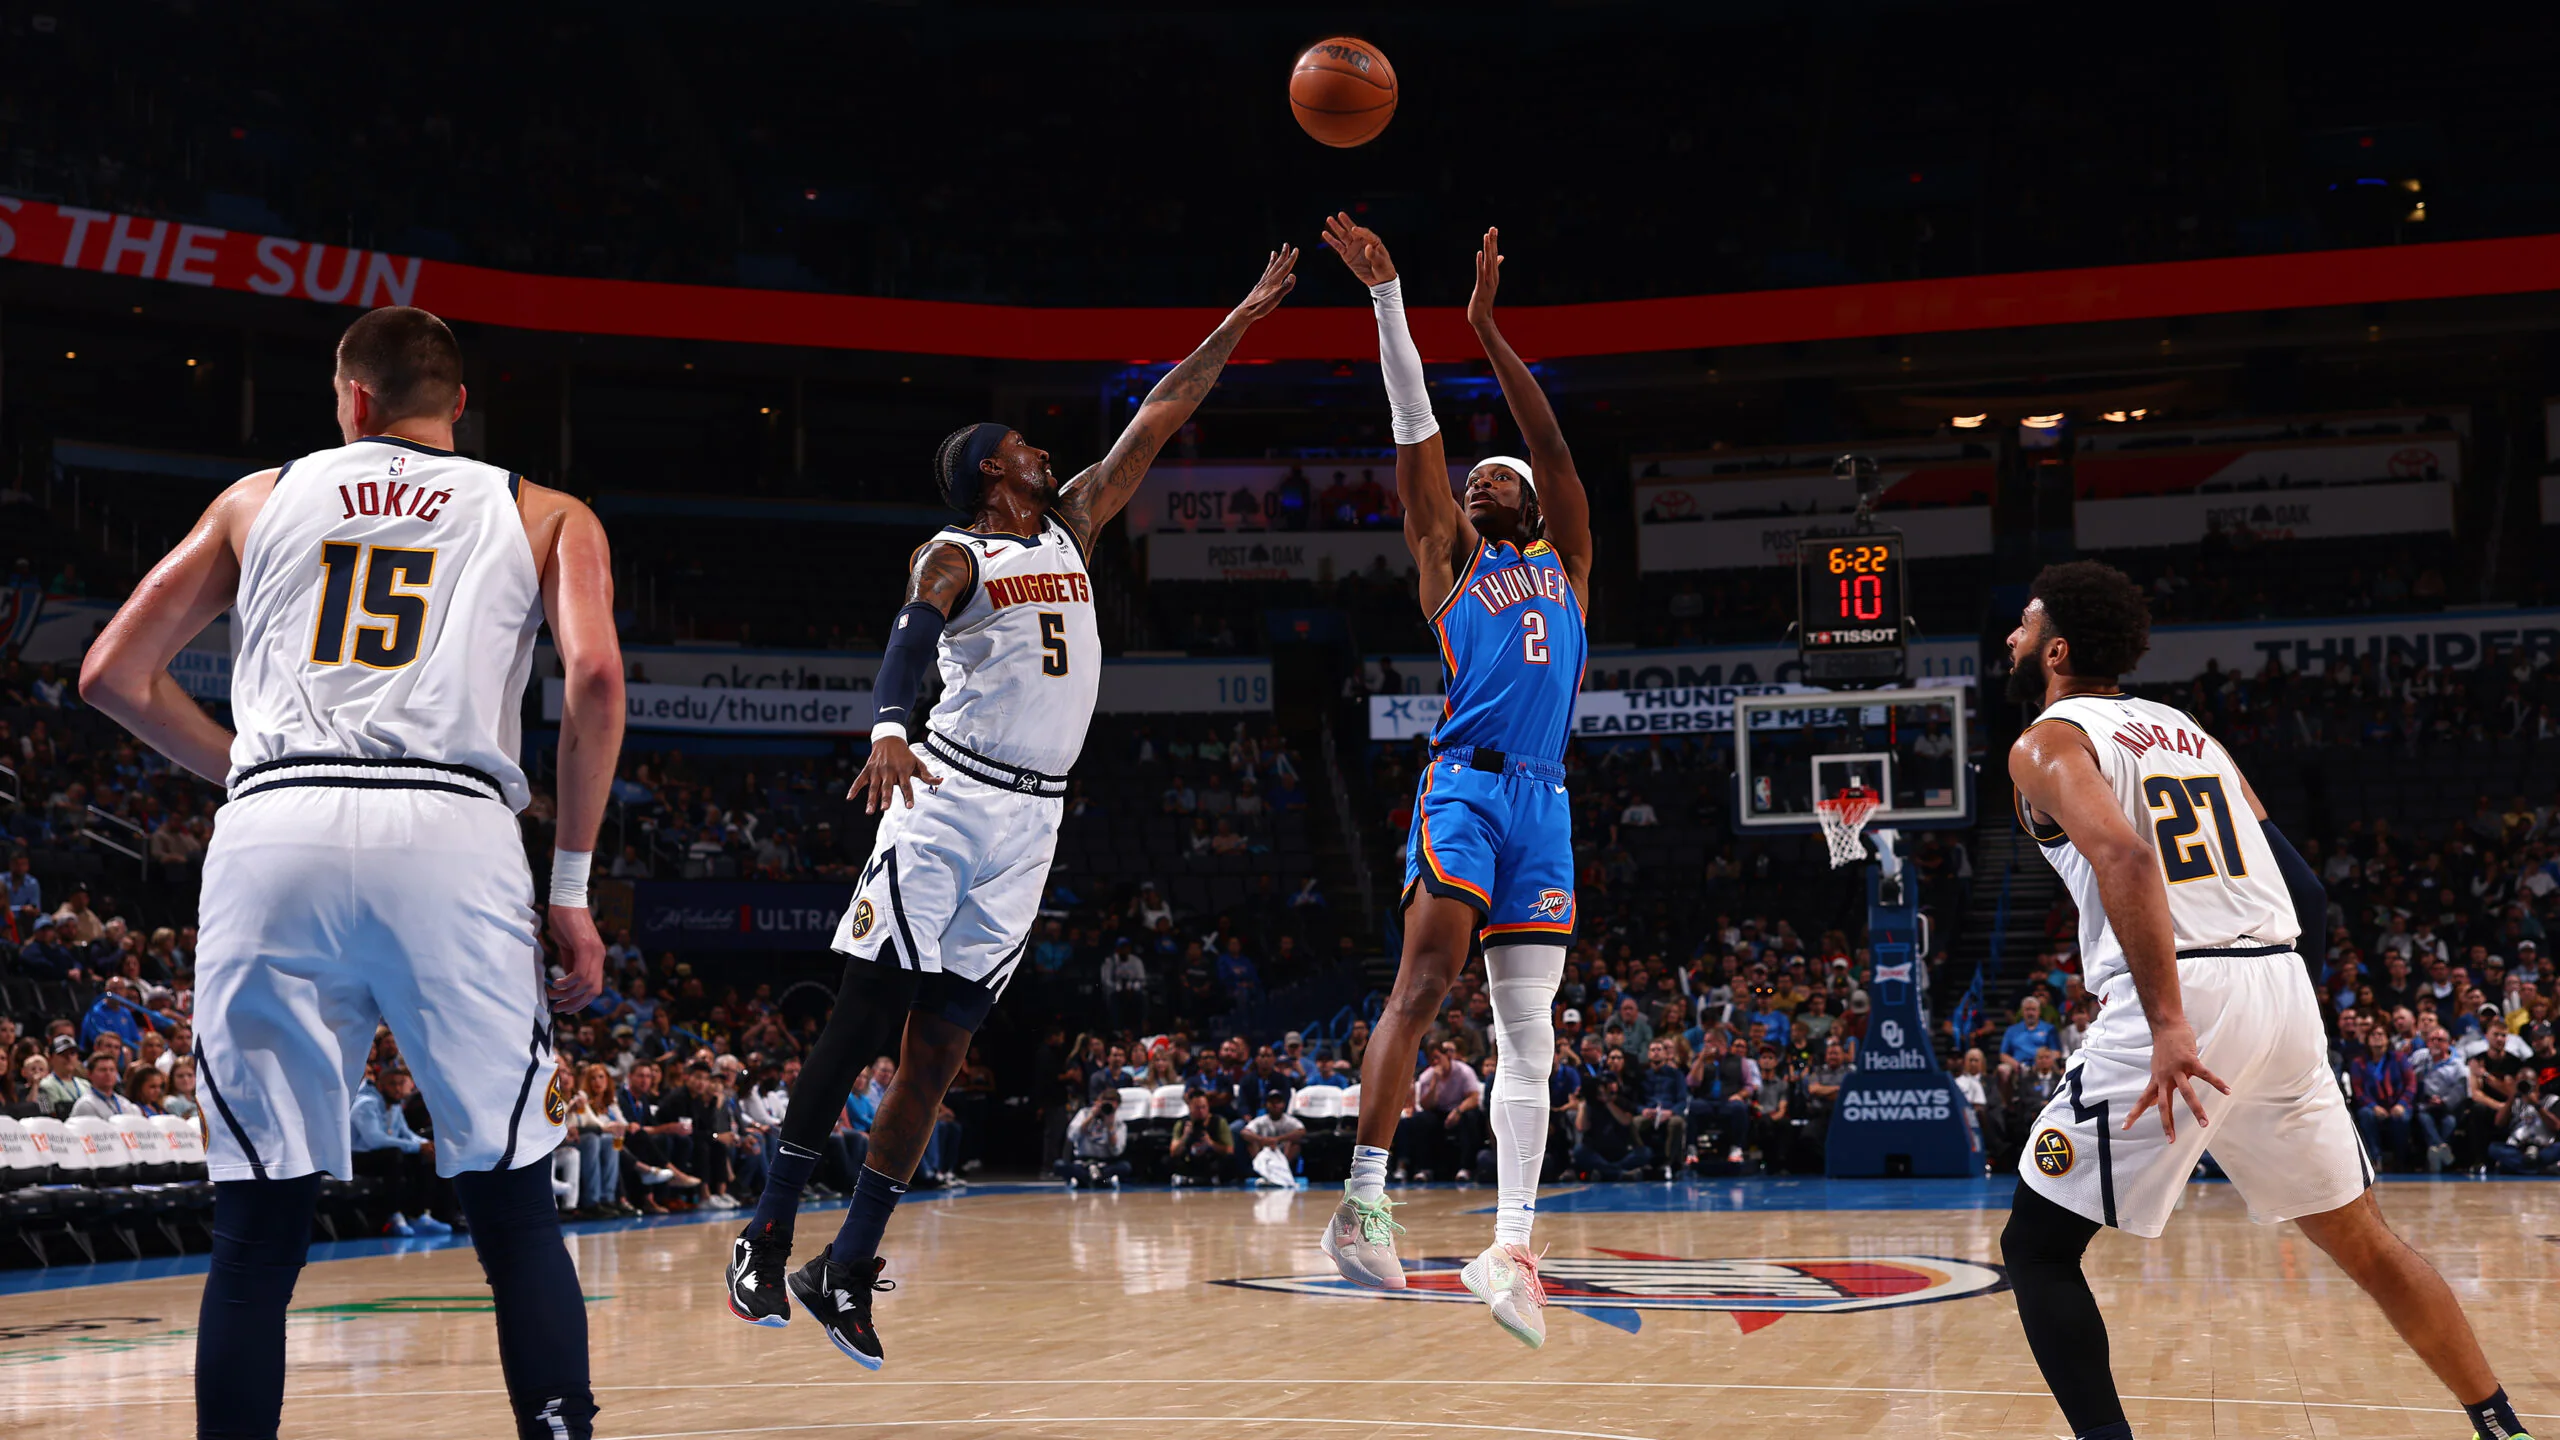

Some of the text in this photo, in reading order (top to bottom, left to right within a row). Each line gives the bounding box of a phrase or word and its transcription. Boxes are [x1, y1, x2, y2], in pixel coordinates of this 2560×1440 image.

[56, 206, 227, 288] THE
[246, 235, 422, 309] SUN
[339, 480, 455, 523] JOKIĆ
[1168, 491, 1226, 521] POST
[2276, 503, 2312, 526] OAK
[1208, 546, 1305, 567] POST OAK
[1827, 545, 1889, 575] 6:22
[984, 571, 1090, 611] NUGGETS
[1468, 563, 1568, 617] THUNDER
[1839, 574, 1883, 621] 10
[310, 540, 438, 671] 15
[1038, 611, 1069, 678] 5
[1522, 609, 1550, 664] 2
[1832, 628, 1898, 643] TISSOT
[2255, 628, 2560, 672] THUNDER
[1217, 676, 1268, 703] 109
[1593, 663, 1761, 690] HOMA
[628, 693, 852, 724] u.edu/thunder
[1571, 706, 1848, 735] EADERSHP MBA
[2142, 773, 2249, 885] 27
[1539, 895, 1565, 912] OKC
[756, 908, 839, 932] ULTRA
[1865, 1048, 1926, 1070] Health
[1843, 1089, 1950, 1106] ALWAYS
[1843, 1106, 1950, 1122] ONWARD
